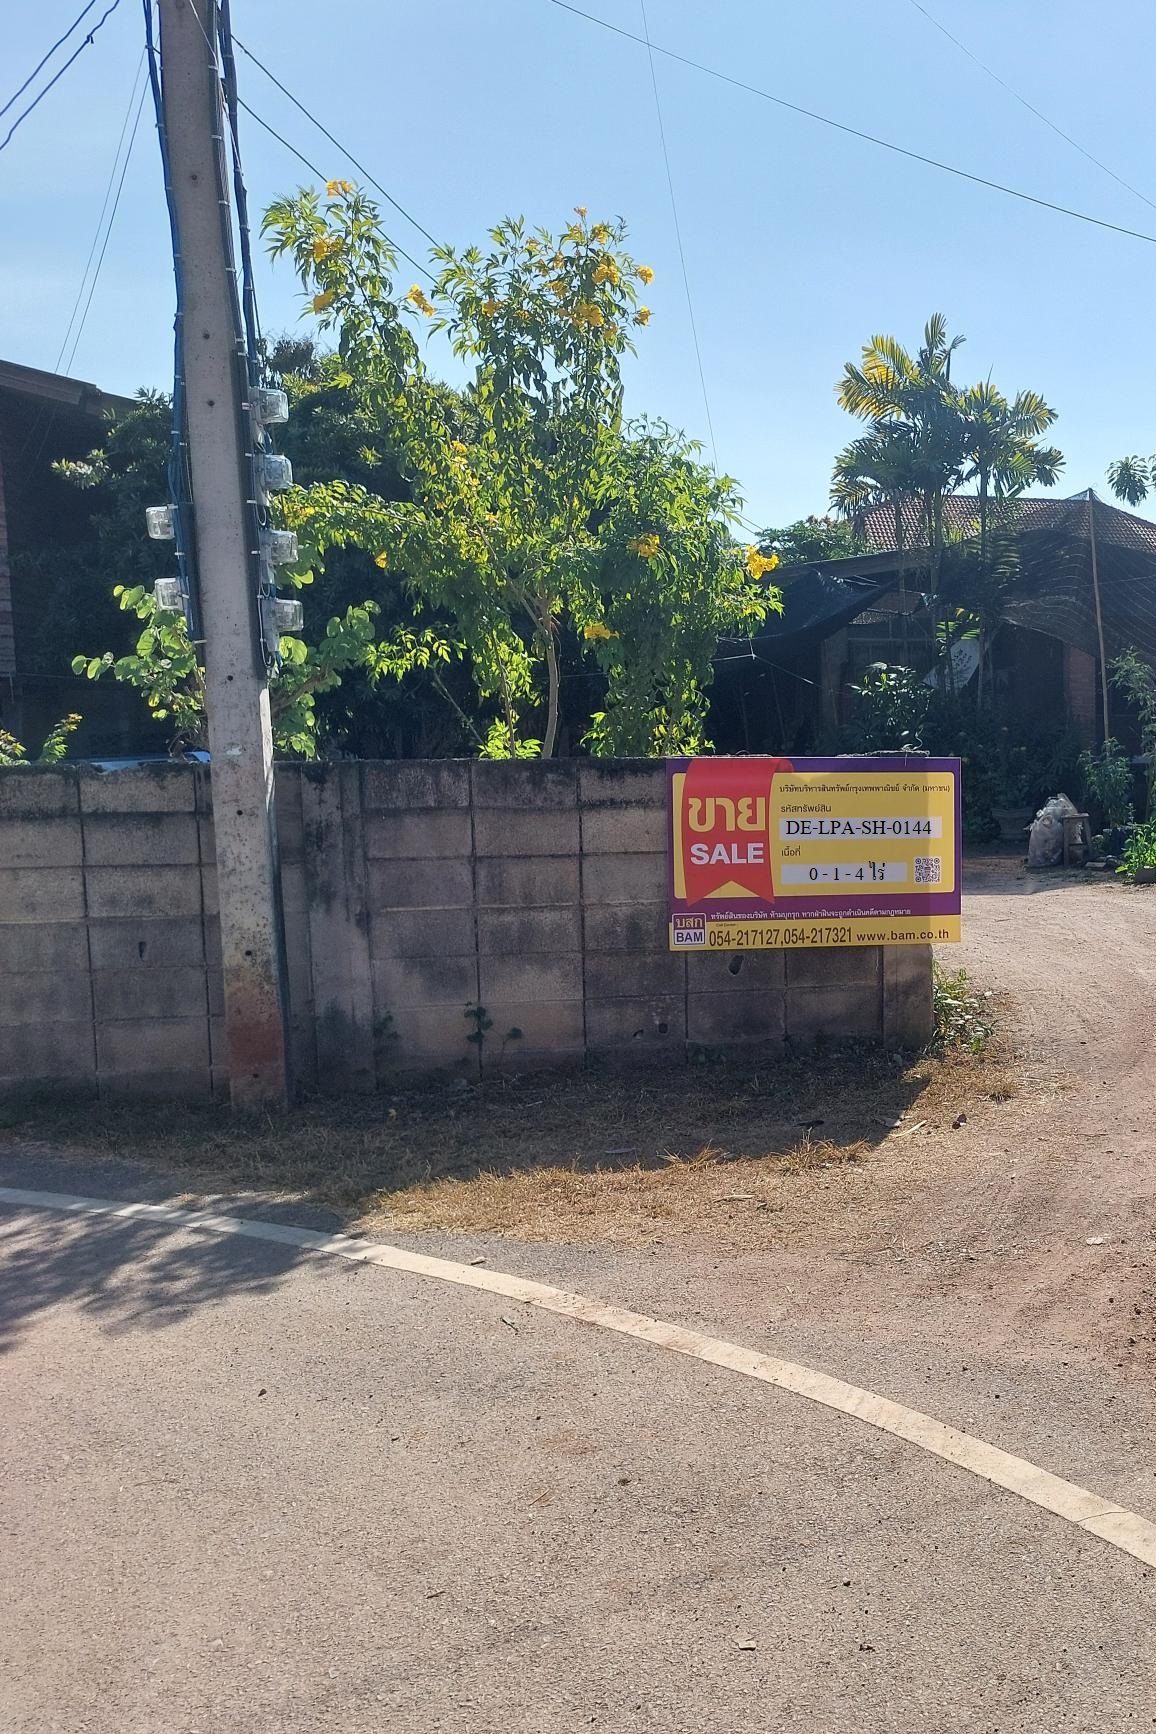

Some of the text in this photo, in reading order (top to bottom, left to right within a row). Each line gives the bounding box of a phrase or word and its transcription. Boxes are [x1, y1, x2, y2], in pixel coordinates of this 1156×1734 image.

[902, 784, 920, 793] จำกัด
[923, 785, 951, 793] (มหาชน)
[780, 803, 832, 813] รหัสทรัพย์สิน
[688, 797, 766, 833] ขาย
[690, 843, 765, 865] SALE
[781, 845, 801, 857] เนื้อที่
[675, 917, 703, 928] บสก
[676, 931, 703, 943] BAM
[709, 927, 949, 946] 054-217127,054-217321 www.bam.co.th
